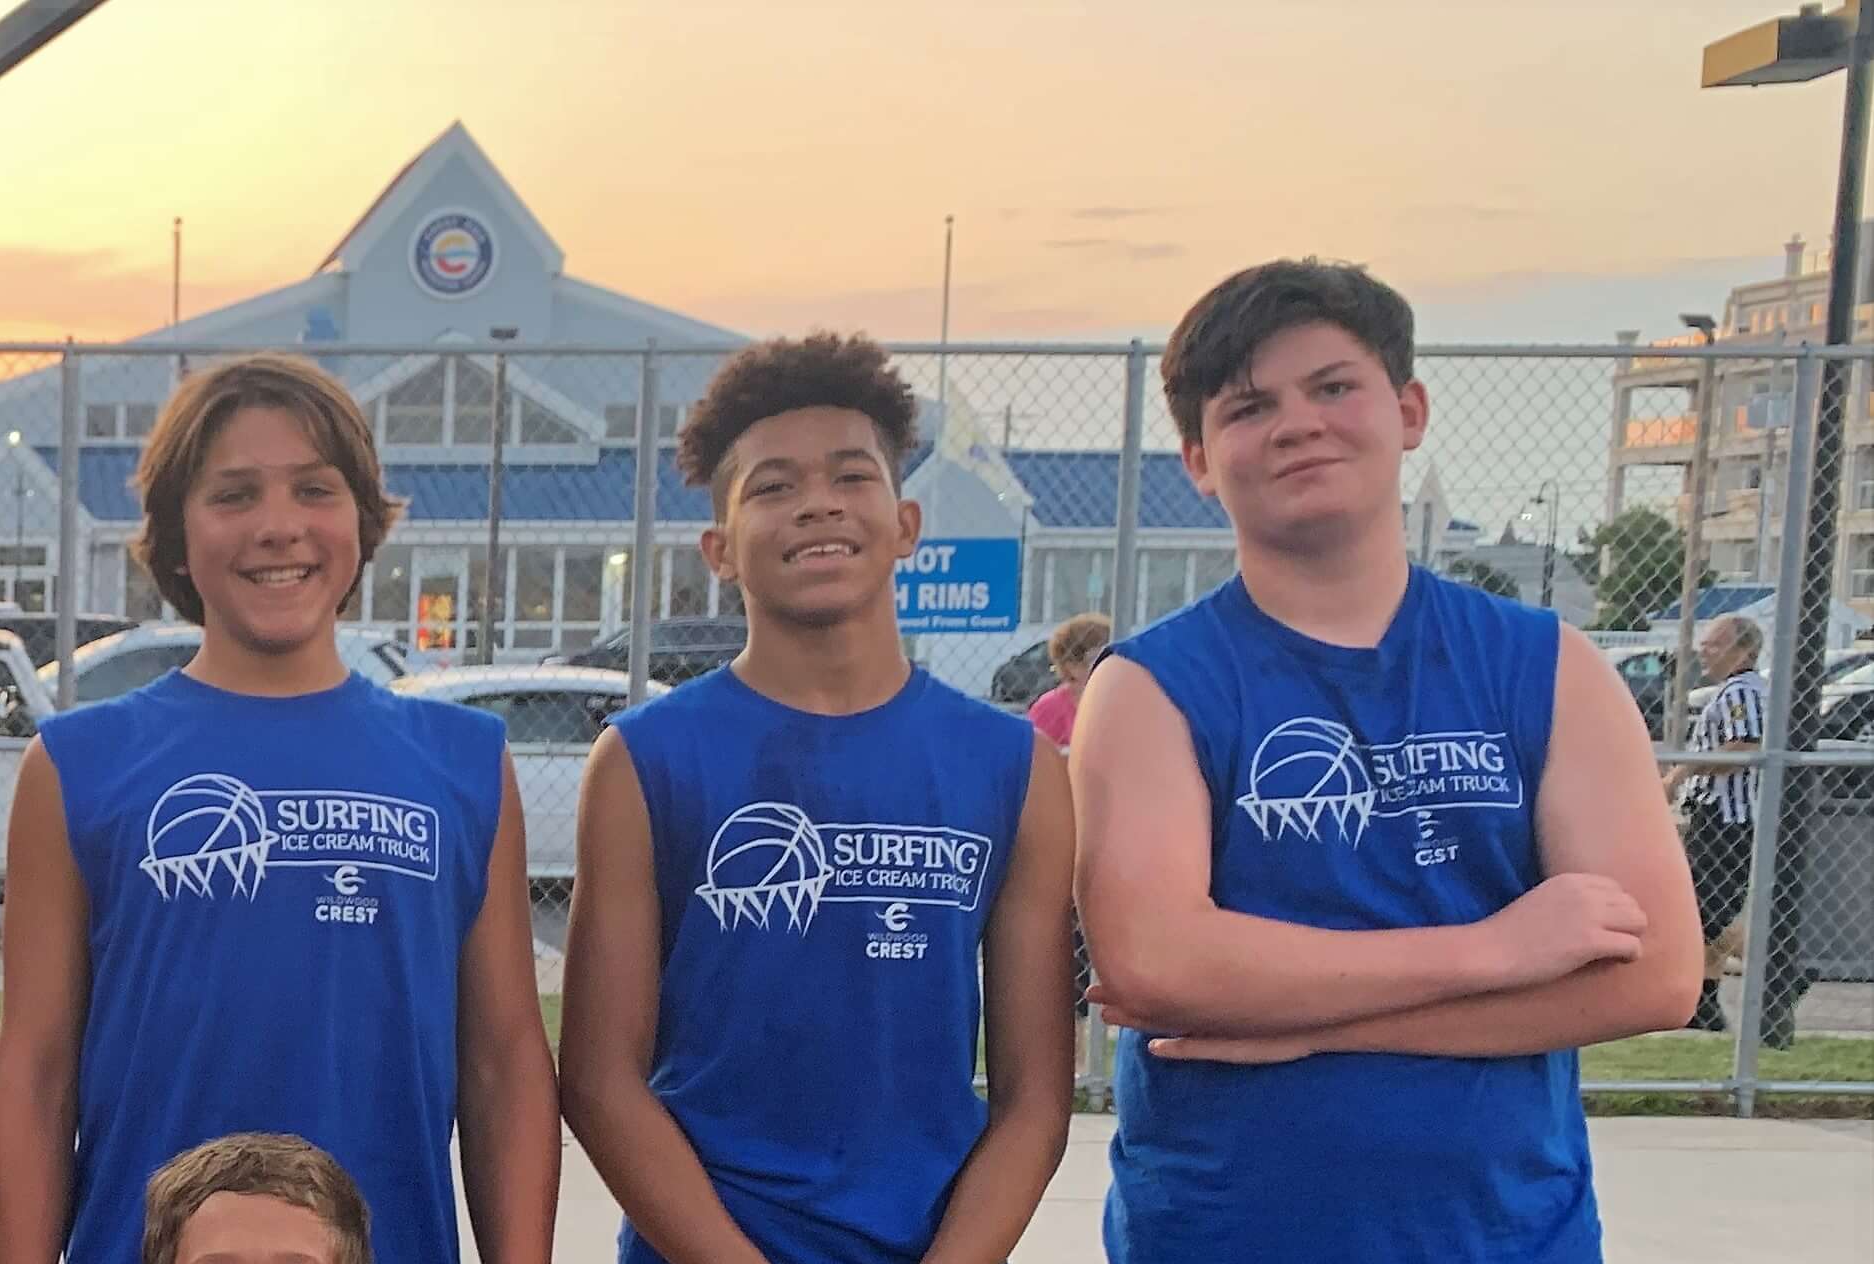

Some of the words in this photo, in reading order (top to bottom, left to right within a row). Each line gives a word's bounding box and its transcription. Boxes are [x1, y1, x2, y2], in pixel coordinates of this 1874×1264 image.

[895, 545, 956, 573] NOT
[918, 582, 989, 611] RIMS
[1449, 775, 1510, 792] TRUCK
[277, 799, 427, 843] SURFING
[281, 834, 310, 851] ICE
[313, 834, 374, 852] CREAM
[377, 837, 430, 864] TRUCK
[833, 832, 980, 875] SURFING
[835, 869, 863, 886] ICE
[873, 869, 927, 889] CREAM
[315, 905, 378, 924] CREST
[867, 932, 928, 943] WILDWOOD
[866, 941, 928, 960] CREST
